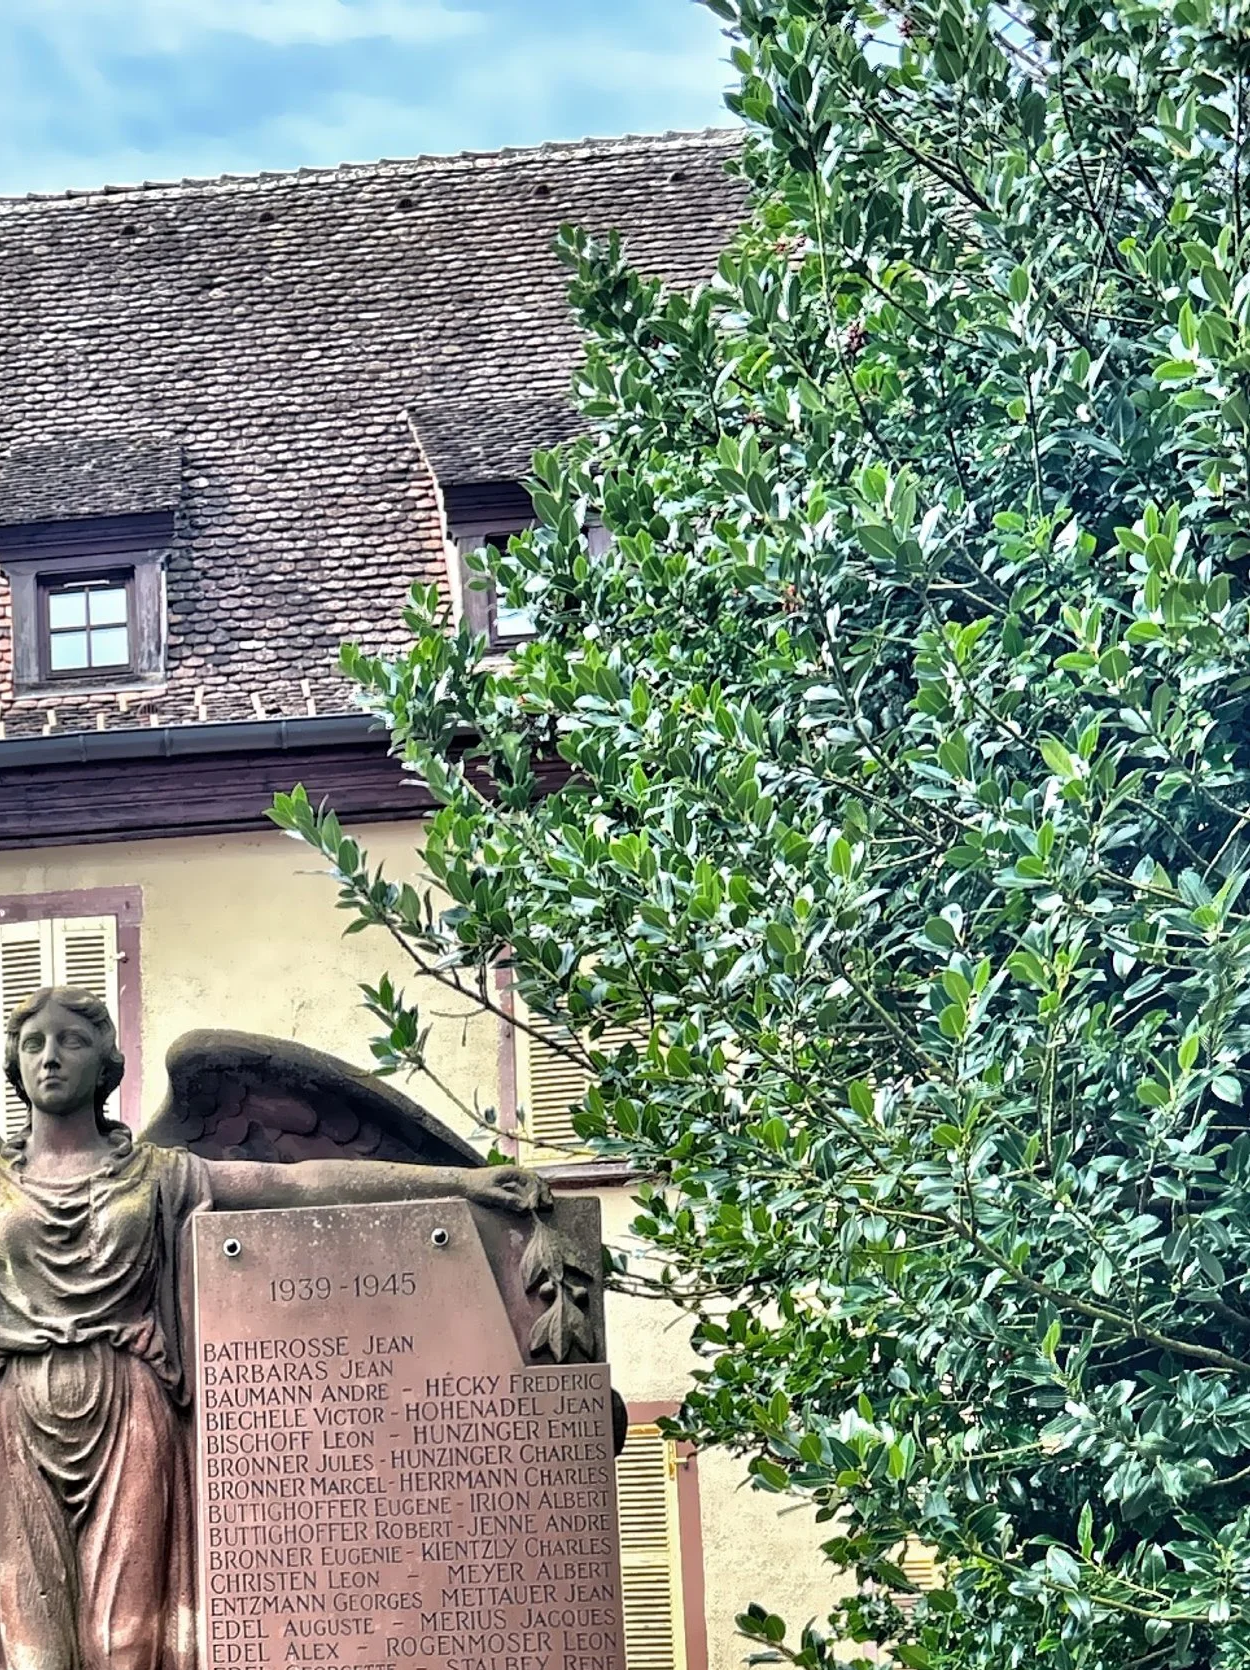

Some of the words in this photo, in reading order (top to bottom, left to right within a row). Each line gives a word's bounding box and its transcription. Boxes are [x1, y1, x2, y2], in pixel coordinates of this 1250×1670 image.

[203, 1336, 348, 1362] BATHEROSSE
[362, 1335, 412, 1355] JEAN
[204, 1384, 311, 1409] BAUMANN
[320, 1382, 389, 1403] ANDRE
[426, 1372, 499, 1398] HÉCKY
[509, 1373, 601, 1393] FREDERIC
[207, 1453, 308, 1477] BRONNER
[315, 1453, 373, 1472] JULES
[391, 1444, 513, 1468] HUNZINGER
[519, 1443, 606, 1463] CHARLES
[209, 1521, 367, 1547] BUTTIGHOFFER
[375, 1520, 452, 1539] ROBERT
[467, 1514, 537, 1536] JENNE
[545, 1514, 609, 1532] ANDRE
[211, 1618, 269, 1640] EDEL
[283, 1617, 374, 1637] AUGUSTE
[420, 1608, 506, 1631] MERIUS
[520, 1608, 614, 1628] JACQUES
